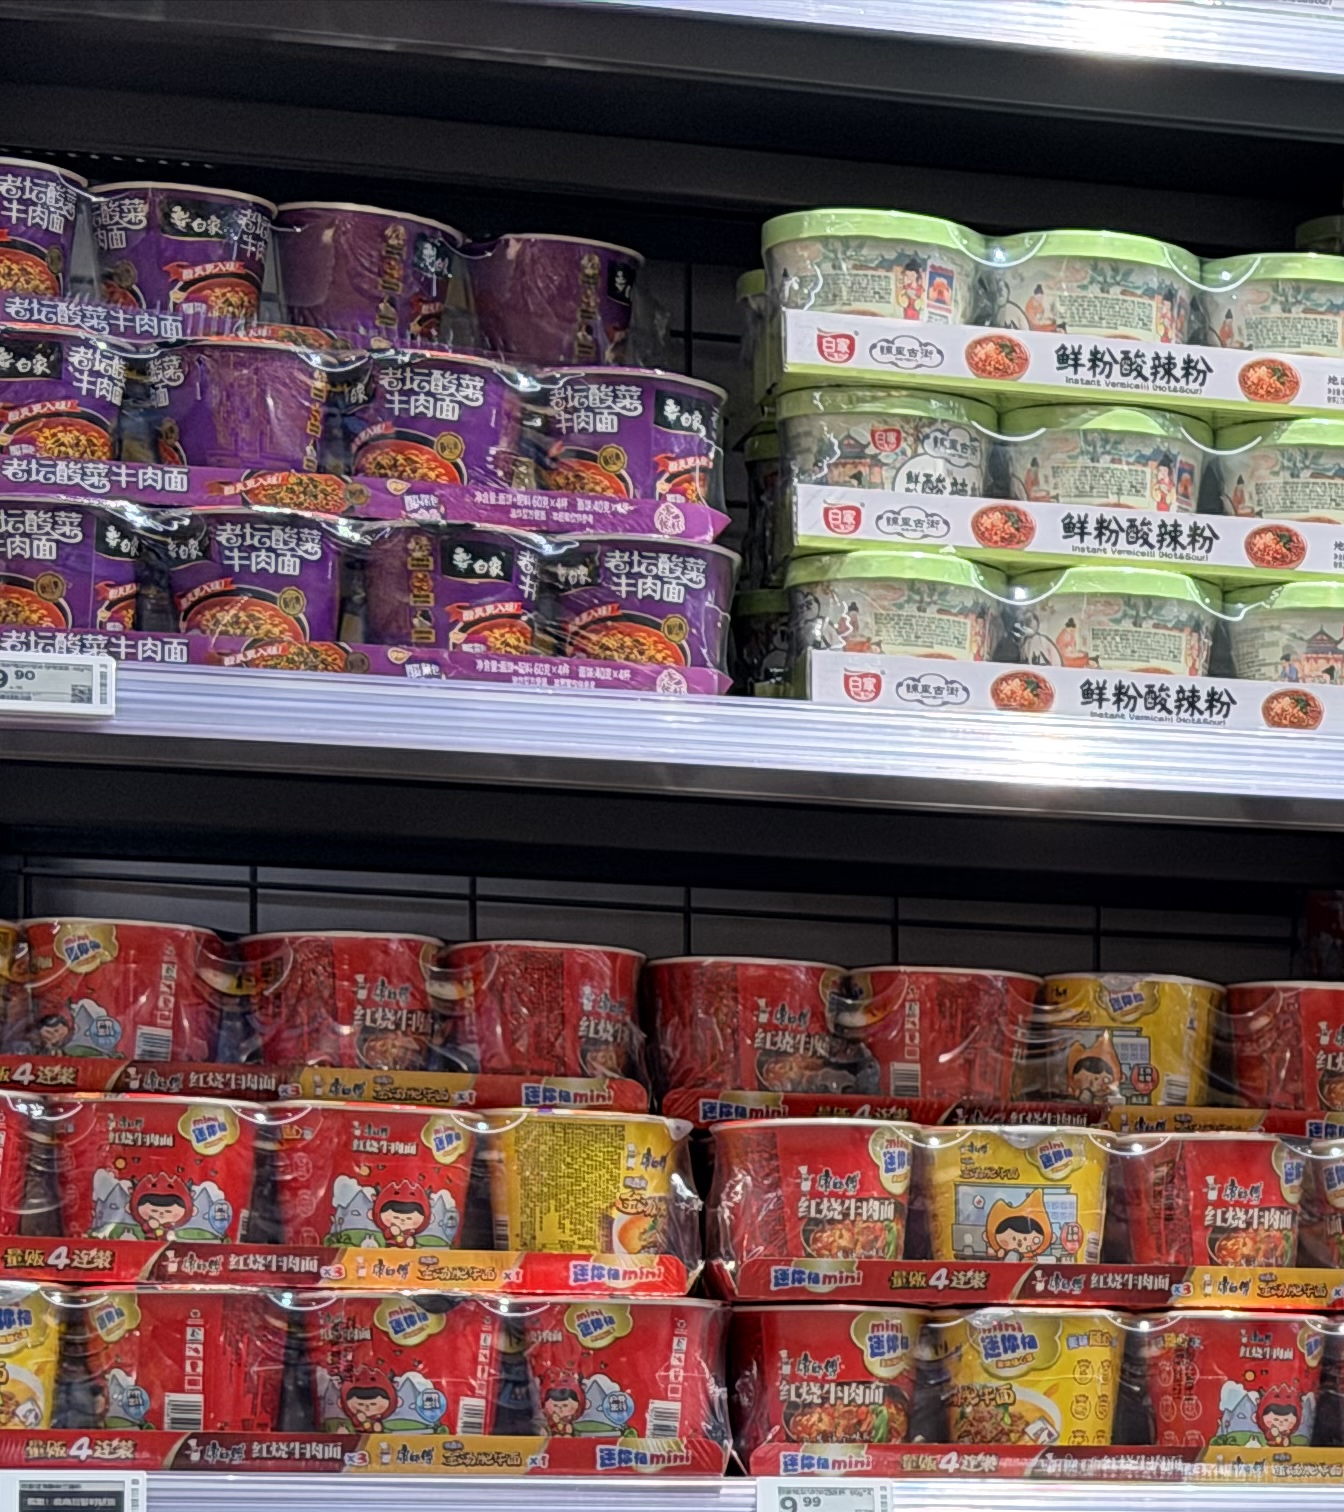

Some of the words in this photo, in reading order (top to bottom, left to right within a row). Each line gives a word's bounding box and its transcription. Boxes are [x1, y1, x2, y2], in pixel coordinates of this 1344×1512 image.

[5, 297, 184, 341] 老坛酸菜牛肉面
[1054, 342, 1214, 387] 鲜粉酸辣粉
[379, 368, 485, 407] 老坛酸菜
[1065, 376, 1101, 386] Instant
[385, 393, 461, 421] 牛肉面
[555, 409, 618, 434] 牛肉面
[1, 457, 190, 493] 老坛酸菜牛肉面
[216, 521, 322, 561] 老坛酸菜
[1060, 512, 1221, 555] 鲜粉酸辣粉
[224, 549, 301, 575] 牛肉面
[1072, 544, 1108, 554] Instant
[605, 549, 707, 590] 老坛酸菜
[611, 576, 686, 603] 牛肉面
[1079, 678, 1238, 720] 鲜粉酸辣粉
[798, 1199, 896, 1221] 红烧牛肉面
[1204, 1206, 1293, 1230] 红烧牛肉面
[229, 1254, 319, 1272] 红烧牛肉面
[1090, 1272, 1171, 1291] 红烧牛肉面
[779, 1380, 885, 1405] 红烧牛肉面
[252, 1442, 342, 1460] 红烧牛肉面
[802, 1496, 822, 1508] 99
